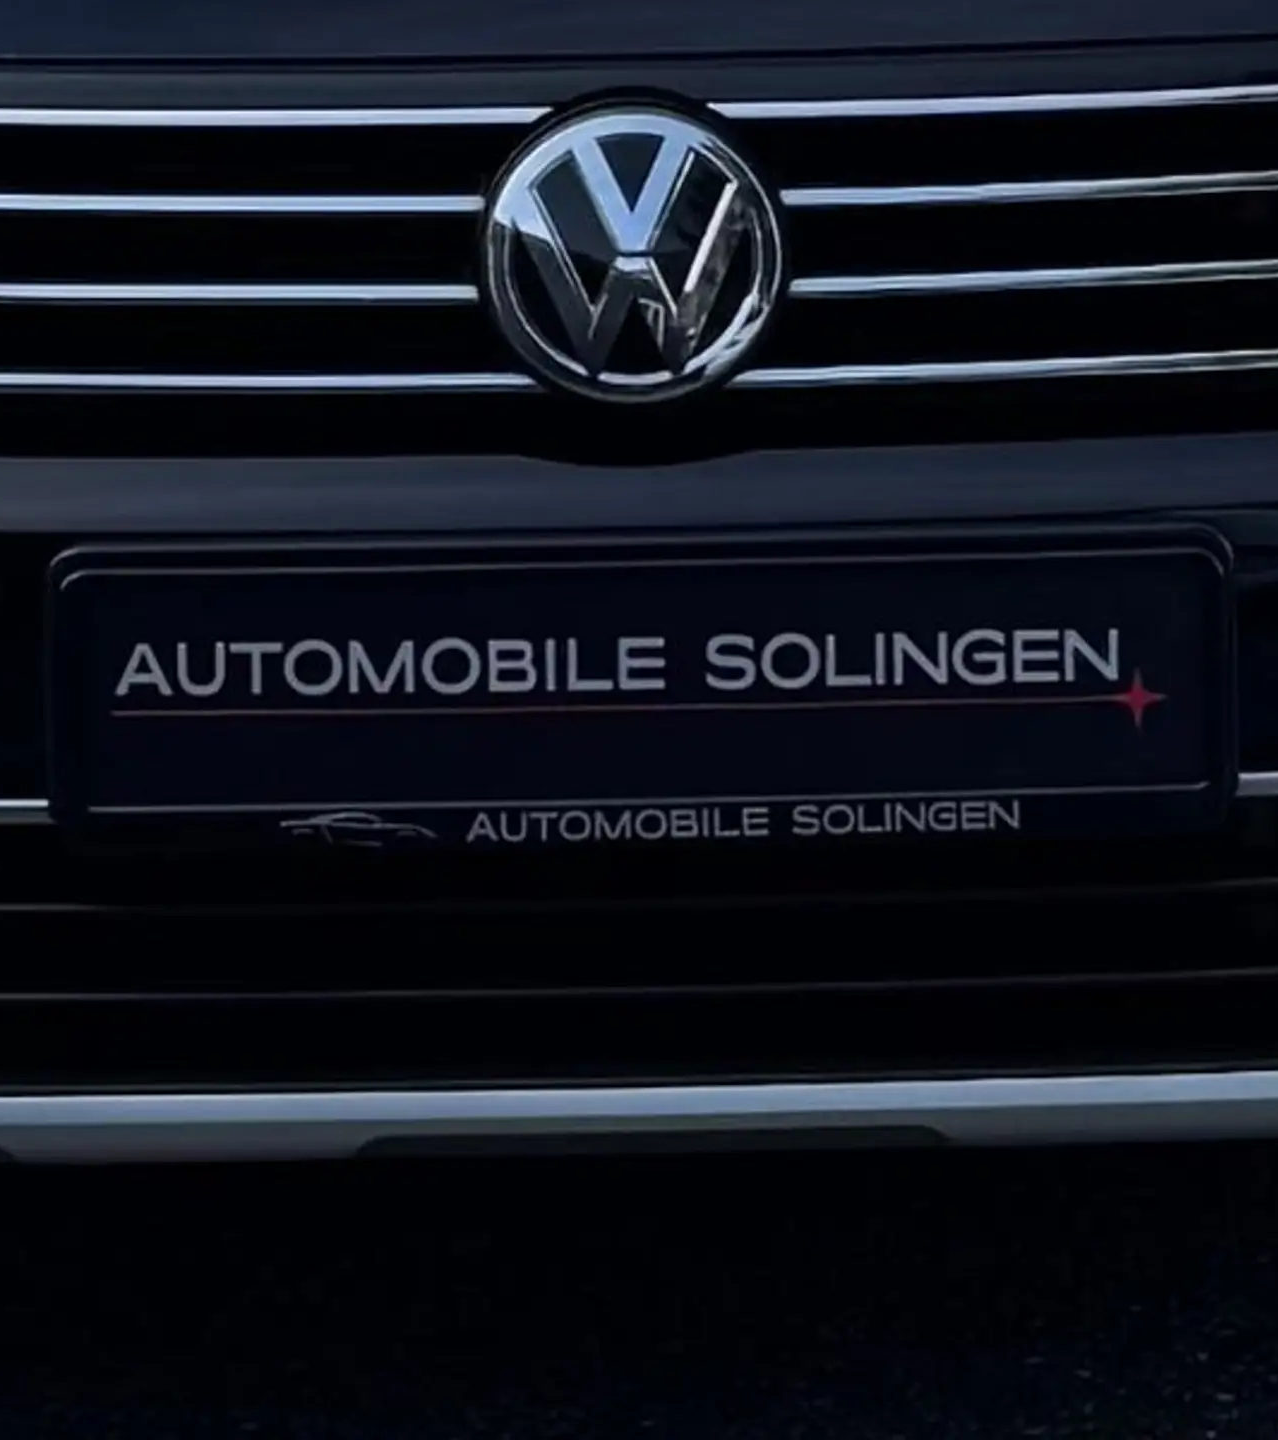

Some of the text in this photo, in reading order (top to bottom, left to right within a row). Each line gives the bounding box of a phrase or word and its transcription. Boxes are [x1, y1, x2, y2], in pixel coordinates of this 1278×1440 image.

[114, 627, 1120, 697] AUTOMOBILE SOLINGEN
[466, 799, 1021, 843] AUTOMOBILE SOLINGEN
